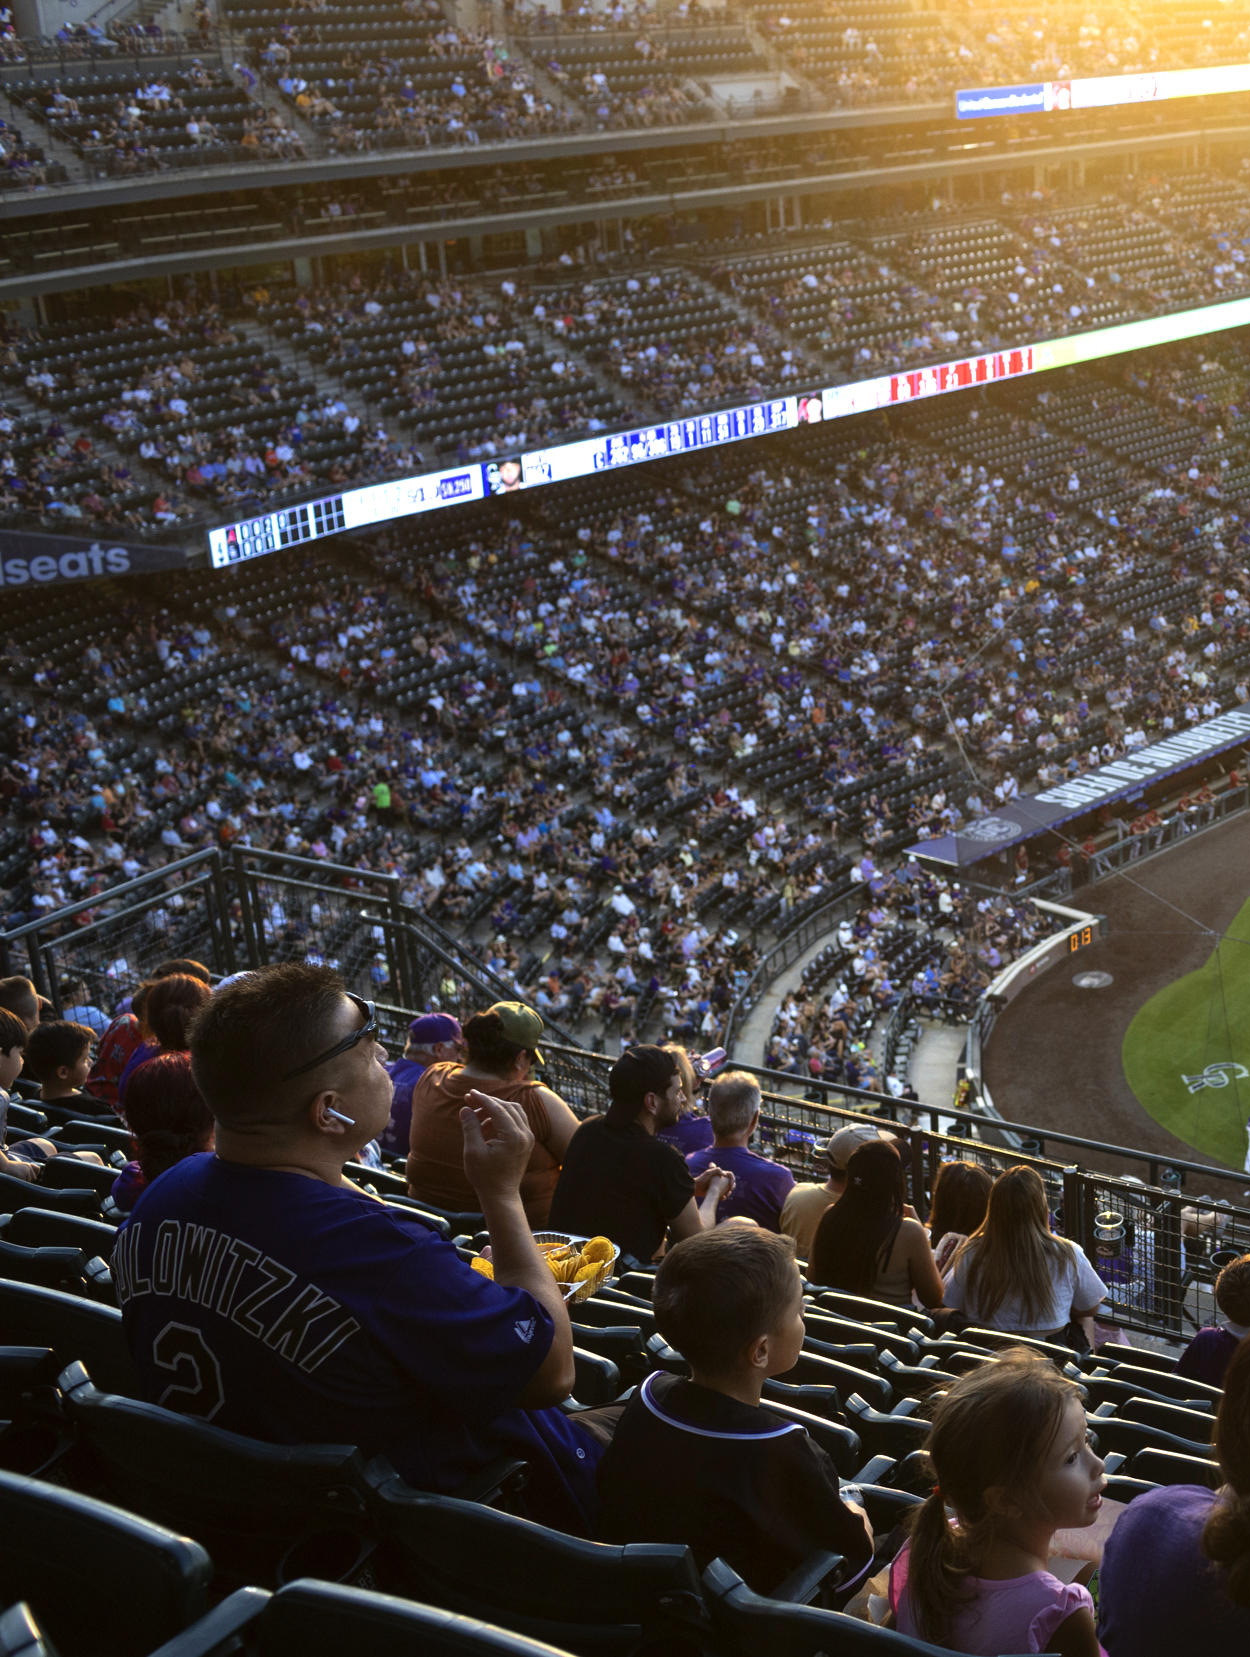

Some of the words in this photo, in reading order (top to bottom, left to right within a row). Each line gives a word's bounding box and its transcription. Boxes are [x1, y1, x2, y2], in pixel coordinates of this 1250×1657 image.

[1099, 760, 1157, 781] 30
[1034, 774, 1130, 809] YEARS
[110, 1219, 362, 1374] ULOWITZKI
